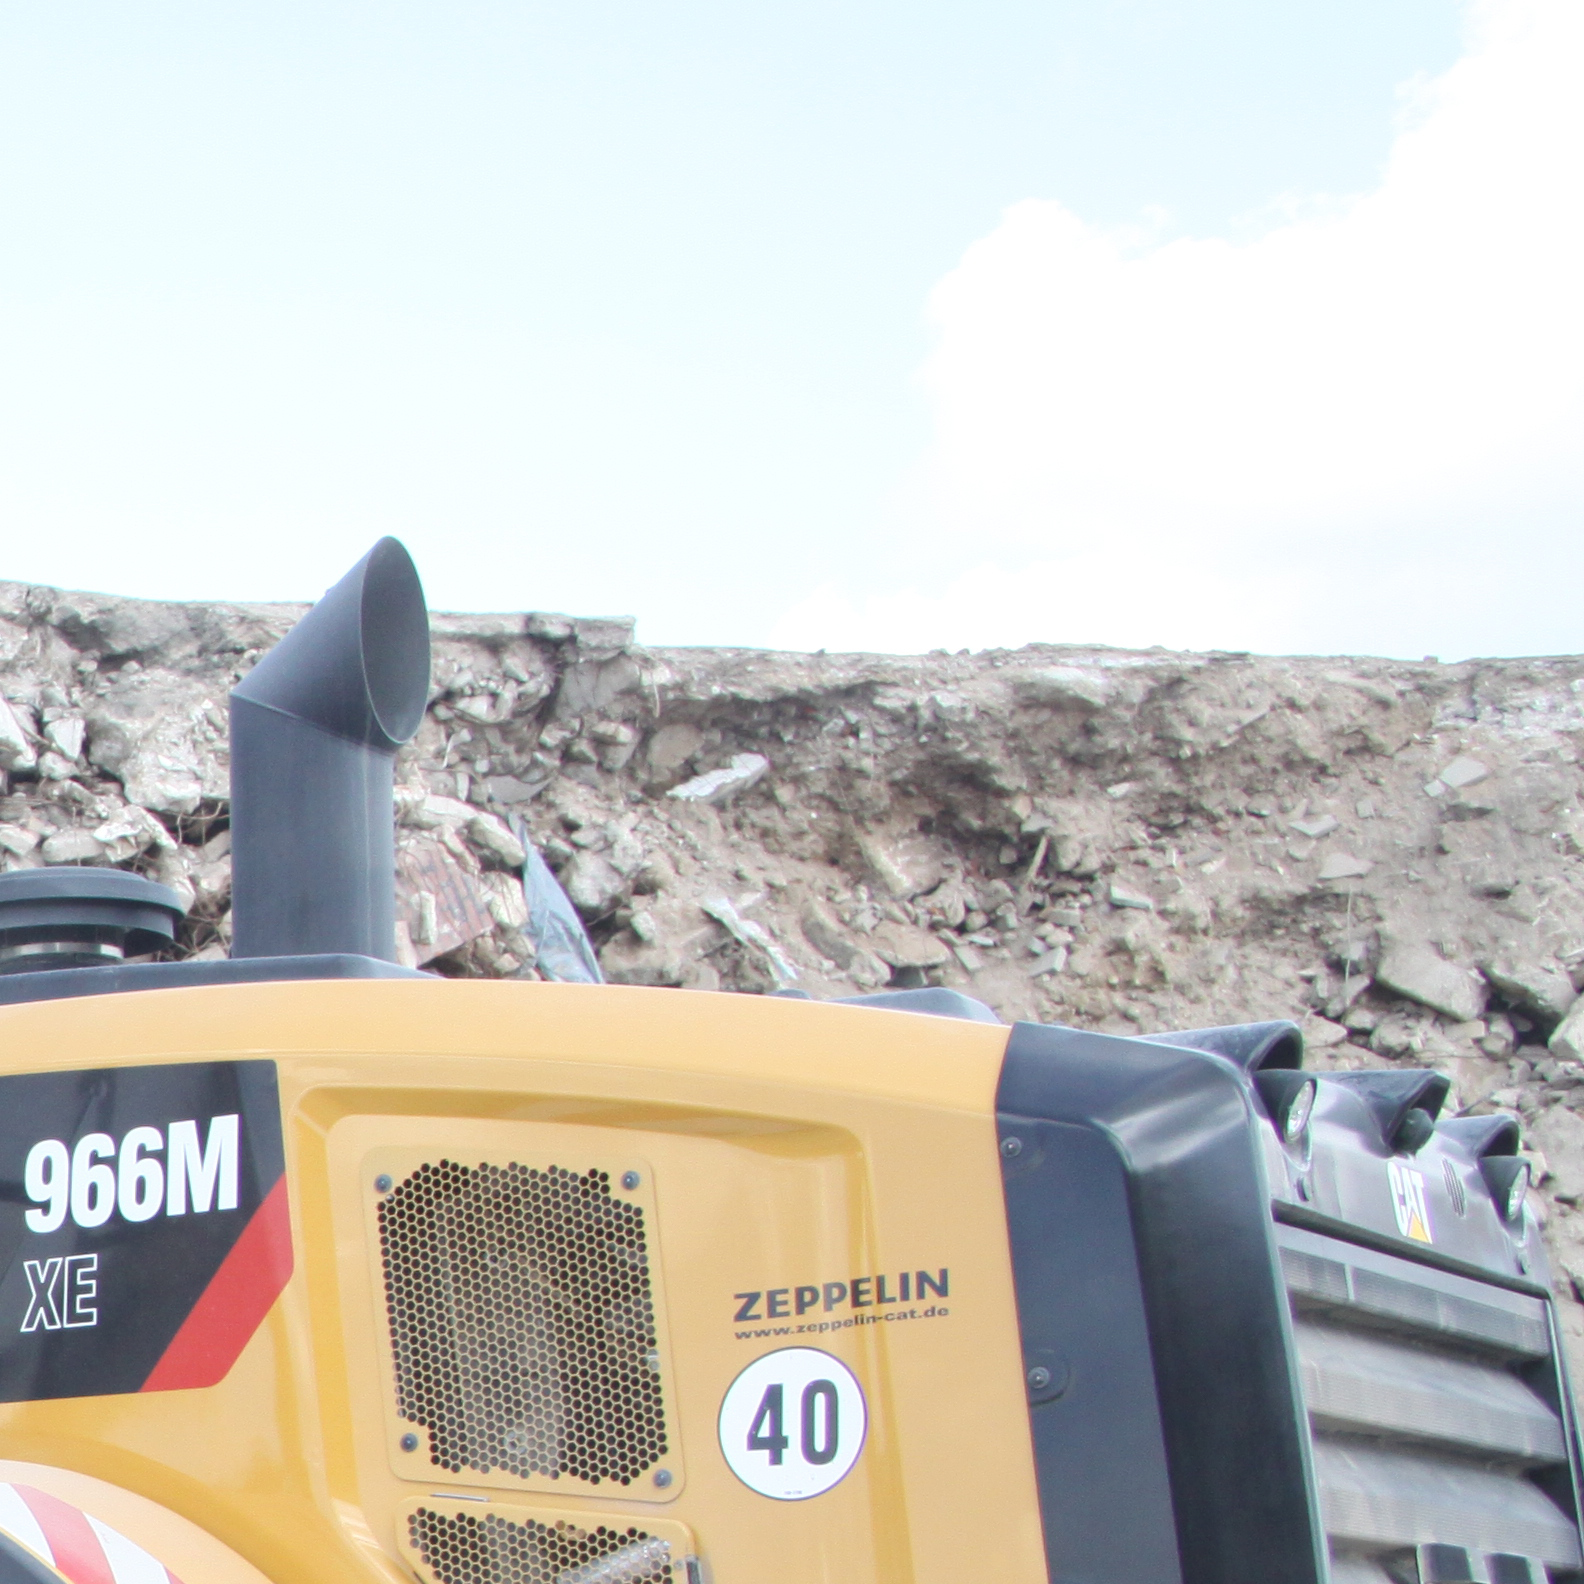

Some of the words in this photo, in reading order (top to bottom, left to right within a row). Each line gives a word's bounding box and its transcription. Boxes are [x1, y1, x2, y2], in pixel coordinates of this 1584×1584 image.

[25, 1114, 239, 1233] 966M
[1387, 1161, 1433, 1244] CAT
[20, 1253, 98, 1332] XE
[733, 1268, 949, 1322] ZEPPELIN
[734, 1306, 950, 1340] www.zeppelin-cat.de
[746, 1379, 839, 1467] 40
